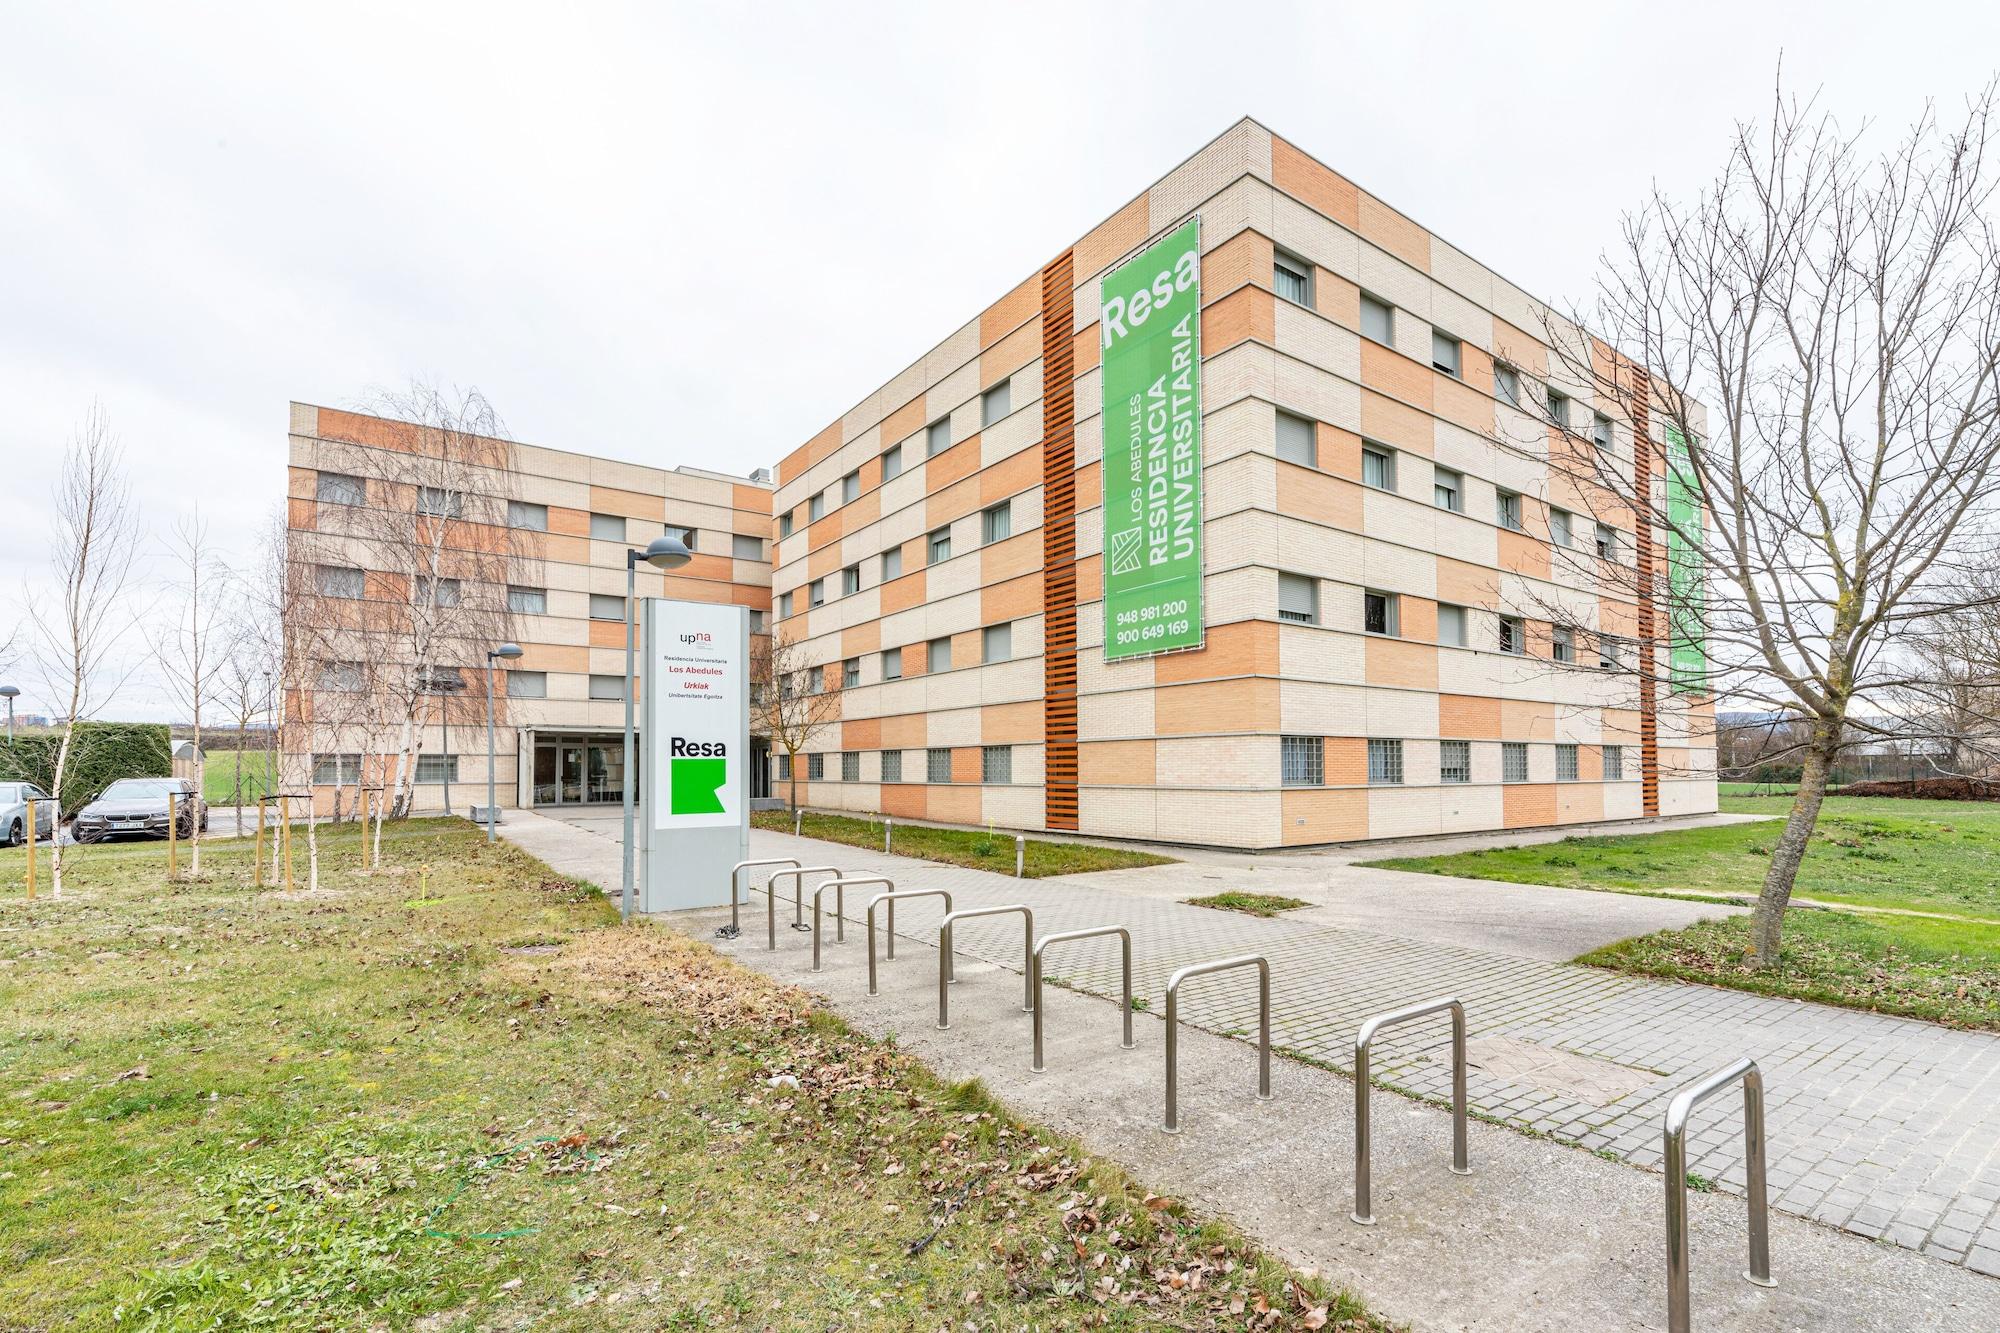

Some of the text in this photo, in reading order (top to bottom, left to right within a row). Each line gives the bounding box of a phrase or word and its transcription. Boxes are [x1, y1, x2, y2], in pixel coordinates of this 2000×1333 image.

[1102, 250, 1197, 350] Resa
[1171, 312, 1194, 560] UNIVERSITARIA
[1130, 393, 1143, 522] LOS ABEDULES
[1147, 374, 1168, 566] RESIDENCIA
[1116, 599, 1187, 626] 948 981 200
[680, 632, 712, 645] upna
[1116, 619, 1189, 645] 900 649 169
[669, 665, 723, 676] Los Abedules
[683, 682, 709, 690] Urkiak
[671, 737, 726, 757] Resa
